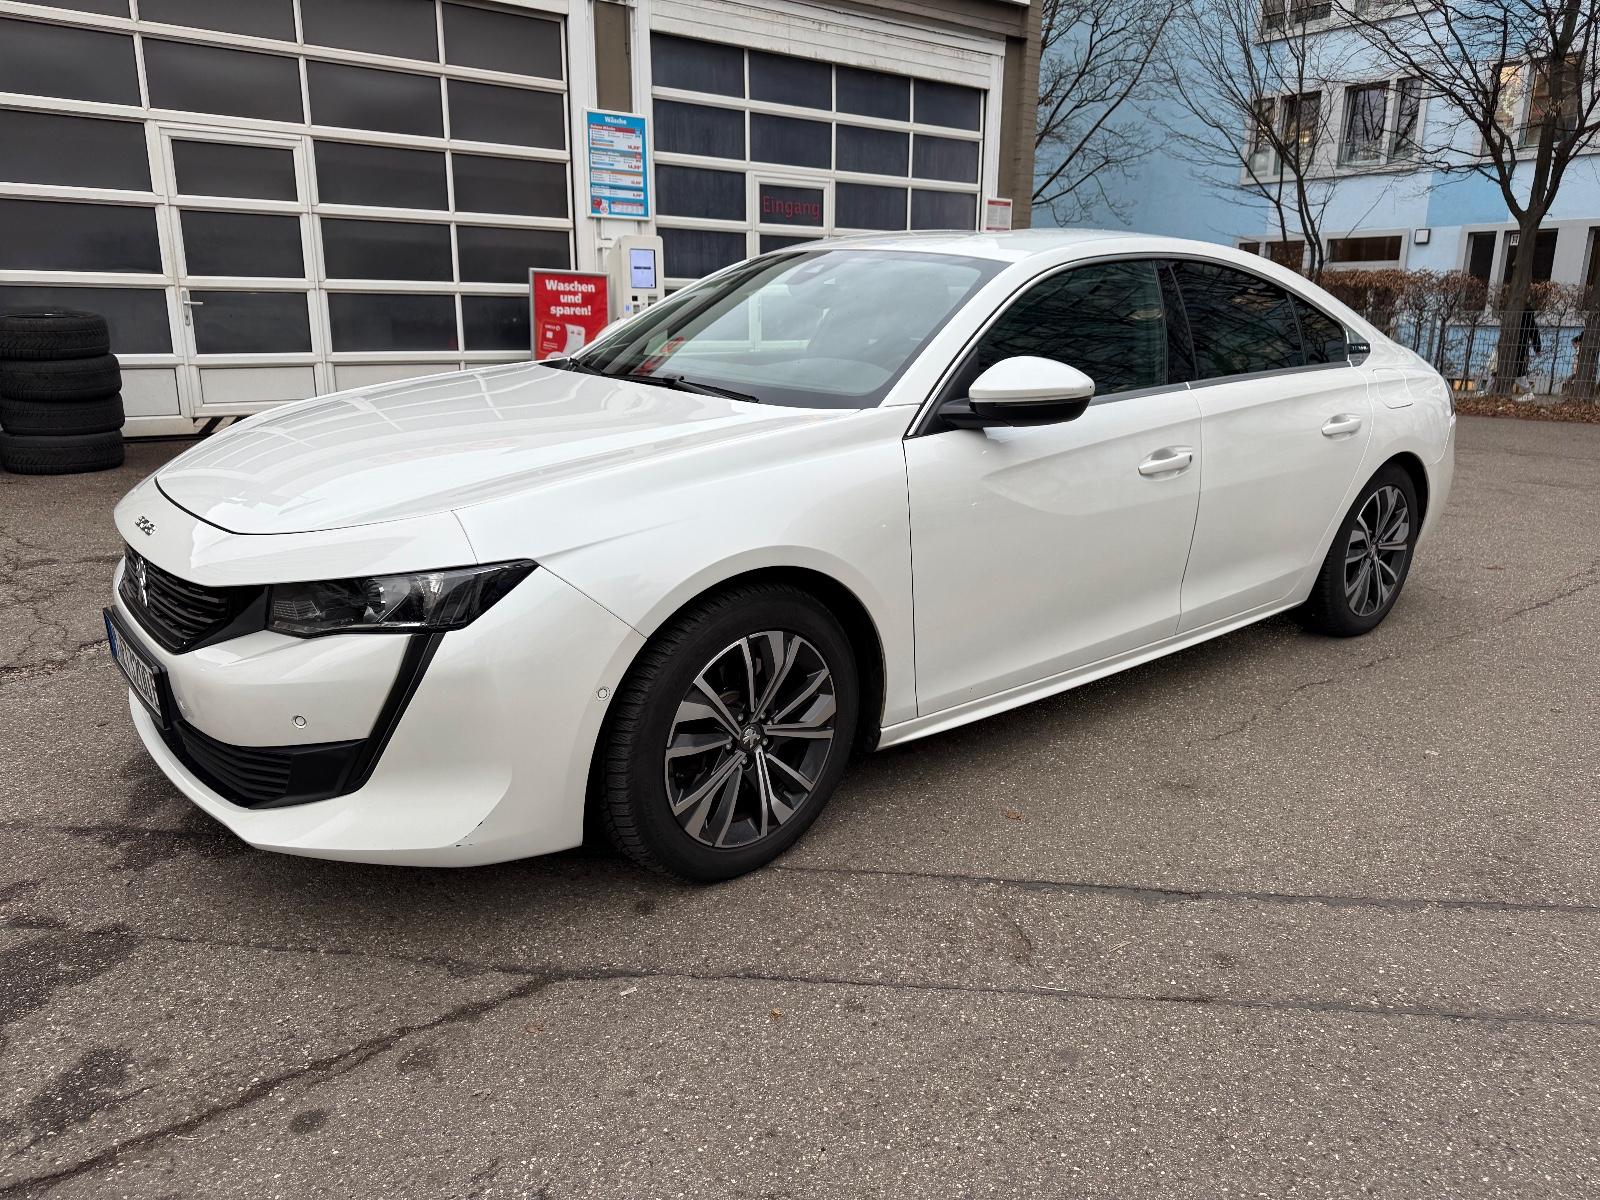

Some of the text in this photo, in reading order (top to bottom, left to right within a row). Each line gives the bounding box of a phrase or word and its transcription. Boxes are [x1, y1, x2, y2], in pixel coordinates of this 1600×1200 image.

[763, 195, 820, 220] Eingang
[545, 279, 596, 293] Waschen
[560, 293, 582, 304] und
[550, 305, 592, 317] sparen!
